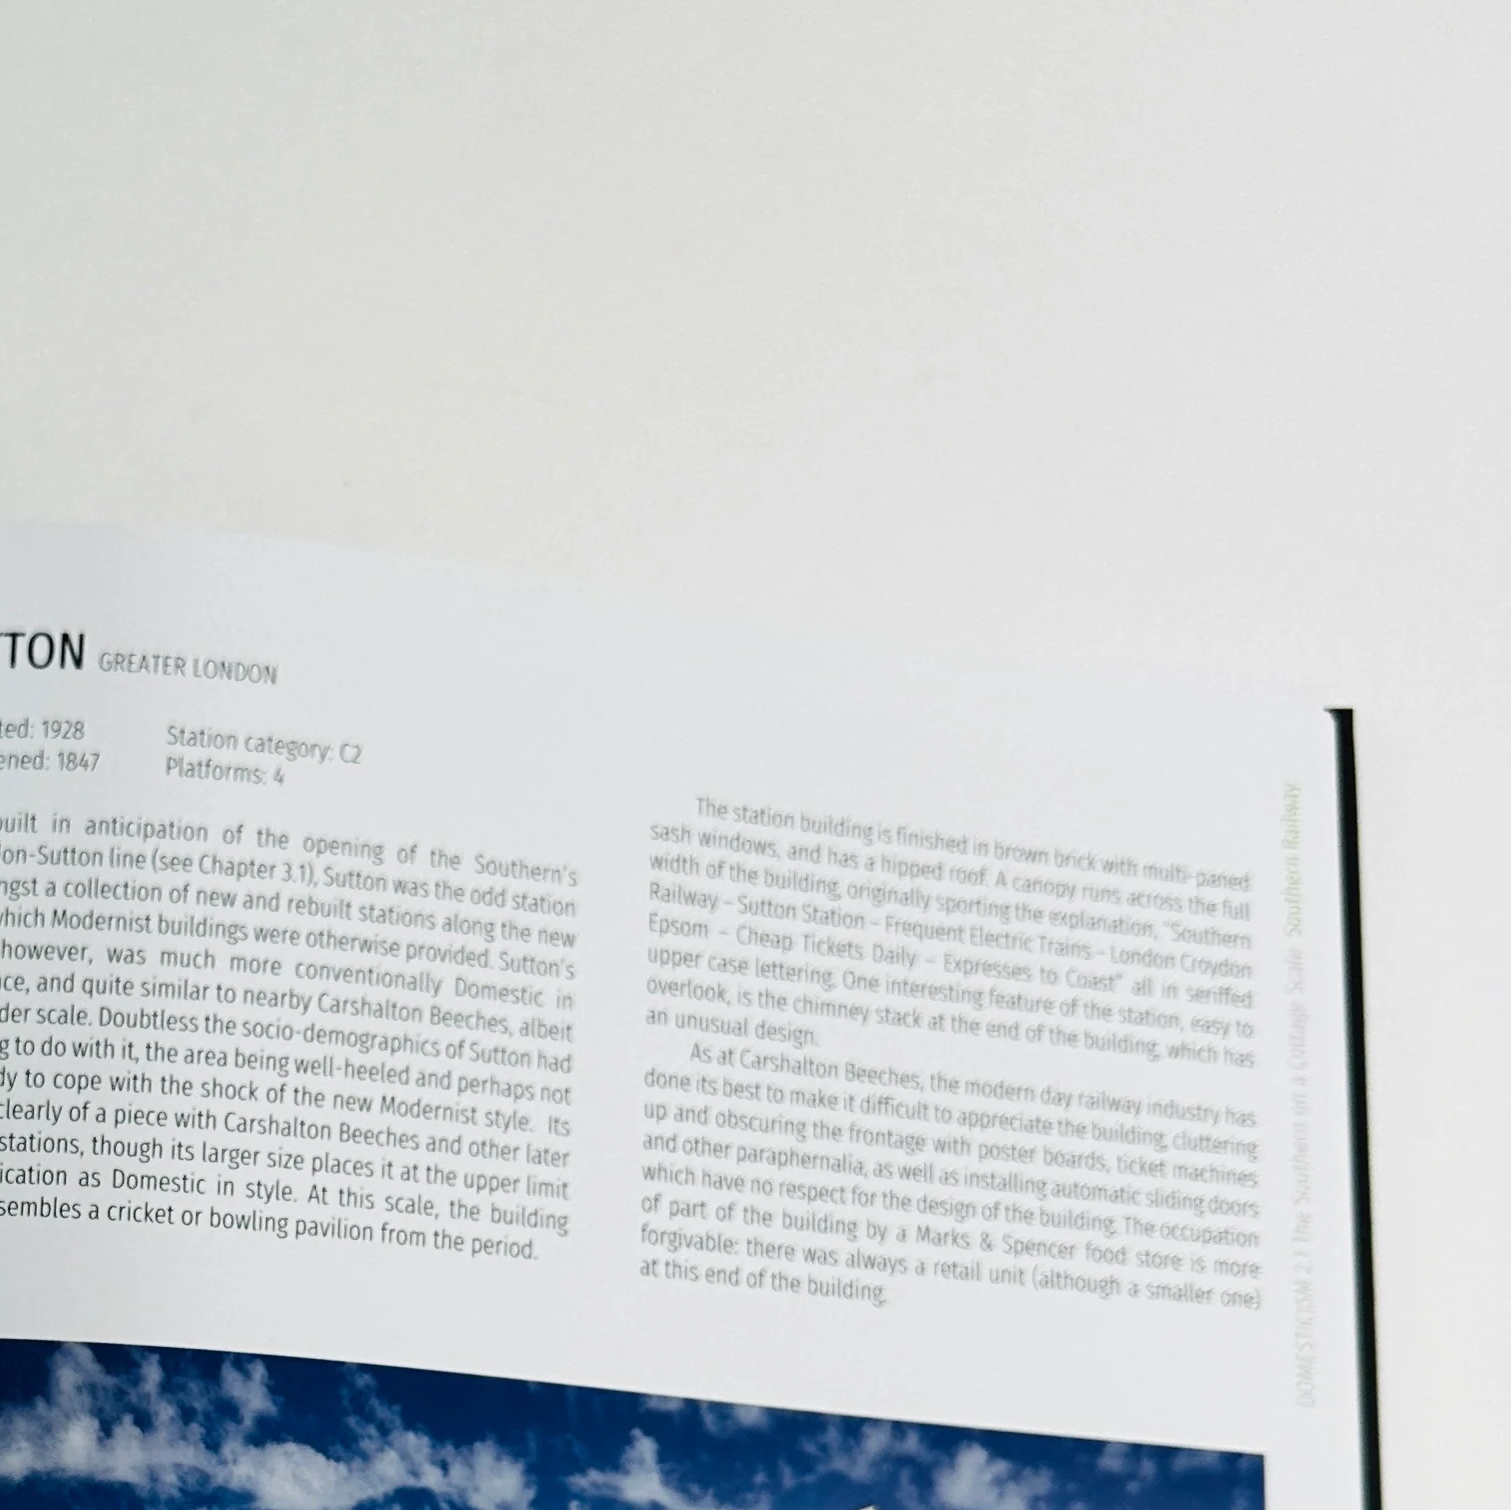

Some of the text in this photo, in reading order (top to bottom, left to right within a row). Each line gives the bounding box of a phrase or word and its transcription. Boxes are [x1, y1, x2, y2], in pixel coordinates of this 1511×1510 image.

[99, 651, 187, 677] GREATER
[192, 658, 278, 685] LONDON
[41, 719, 85, 741] 1928
[166, 724, 239, 750] Station
[243, 735, 333, 764] category:
[57, 751, 101, 772] 1847
[165, 756, 285, 787] Platforms: 4
[1279, 780, 1304, 851] Railway
[52, 817, 71, 834] in
[84, 817, 209, 843] anticipation
[222, 822, 244, 845] of
[256, 826, 290, 851] the
[302, 836, 385, 867] opening
[396, 843, 418, 864] of
[429, 848, 462, 872] the
[474, 853, 578, 888] Southern's
[1280, 856, 1305, 938] Southern
[36, 972, 75, 994] and
[81, 976, 135, 1000] quite
[140, 978, 210, 1001] similar
[216, 983, 237, 1004] to
[243, 988, 313, 1016] nearby
[317, 991, 423, 1023] Carshalton
[429, 1004, 514, 1036] Beeches,
[518, 1016, 573, 1042] albeit
[88, 1203, 99, 1221] a
[107, 1201, 174, 1225] cricket
[181, 1209, 203, 1227] or
[209, 1206, 289, 1239] bowling
[295, 1218, 373, 1242] pavilion
[380, 1221, 426, 1247] from
[433, 1229, 465, 1253] the
[471, 1236, 538, 1260] period.
[639, 1258, 887, 1309] at this end of the building.
[641, 1223, 1262, 1311] forgivable: there was always a retail unit (although a smaller one)
